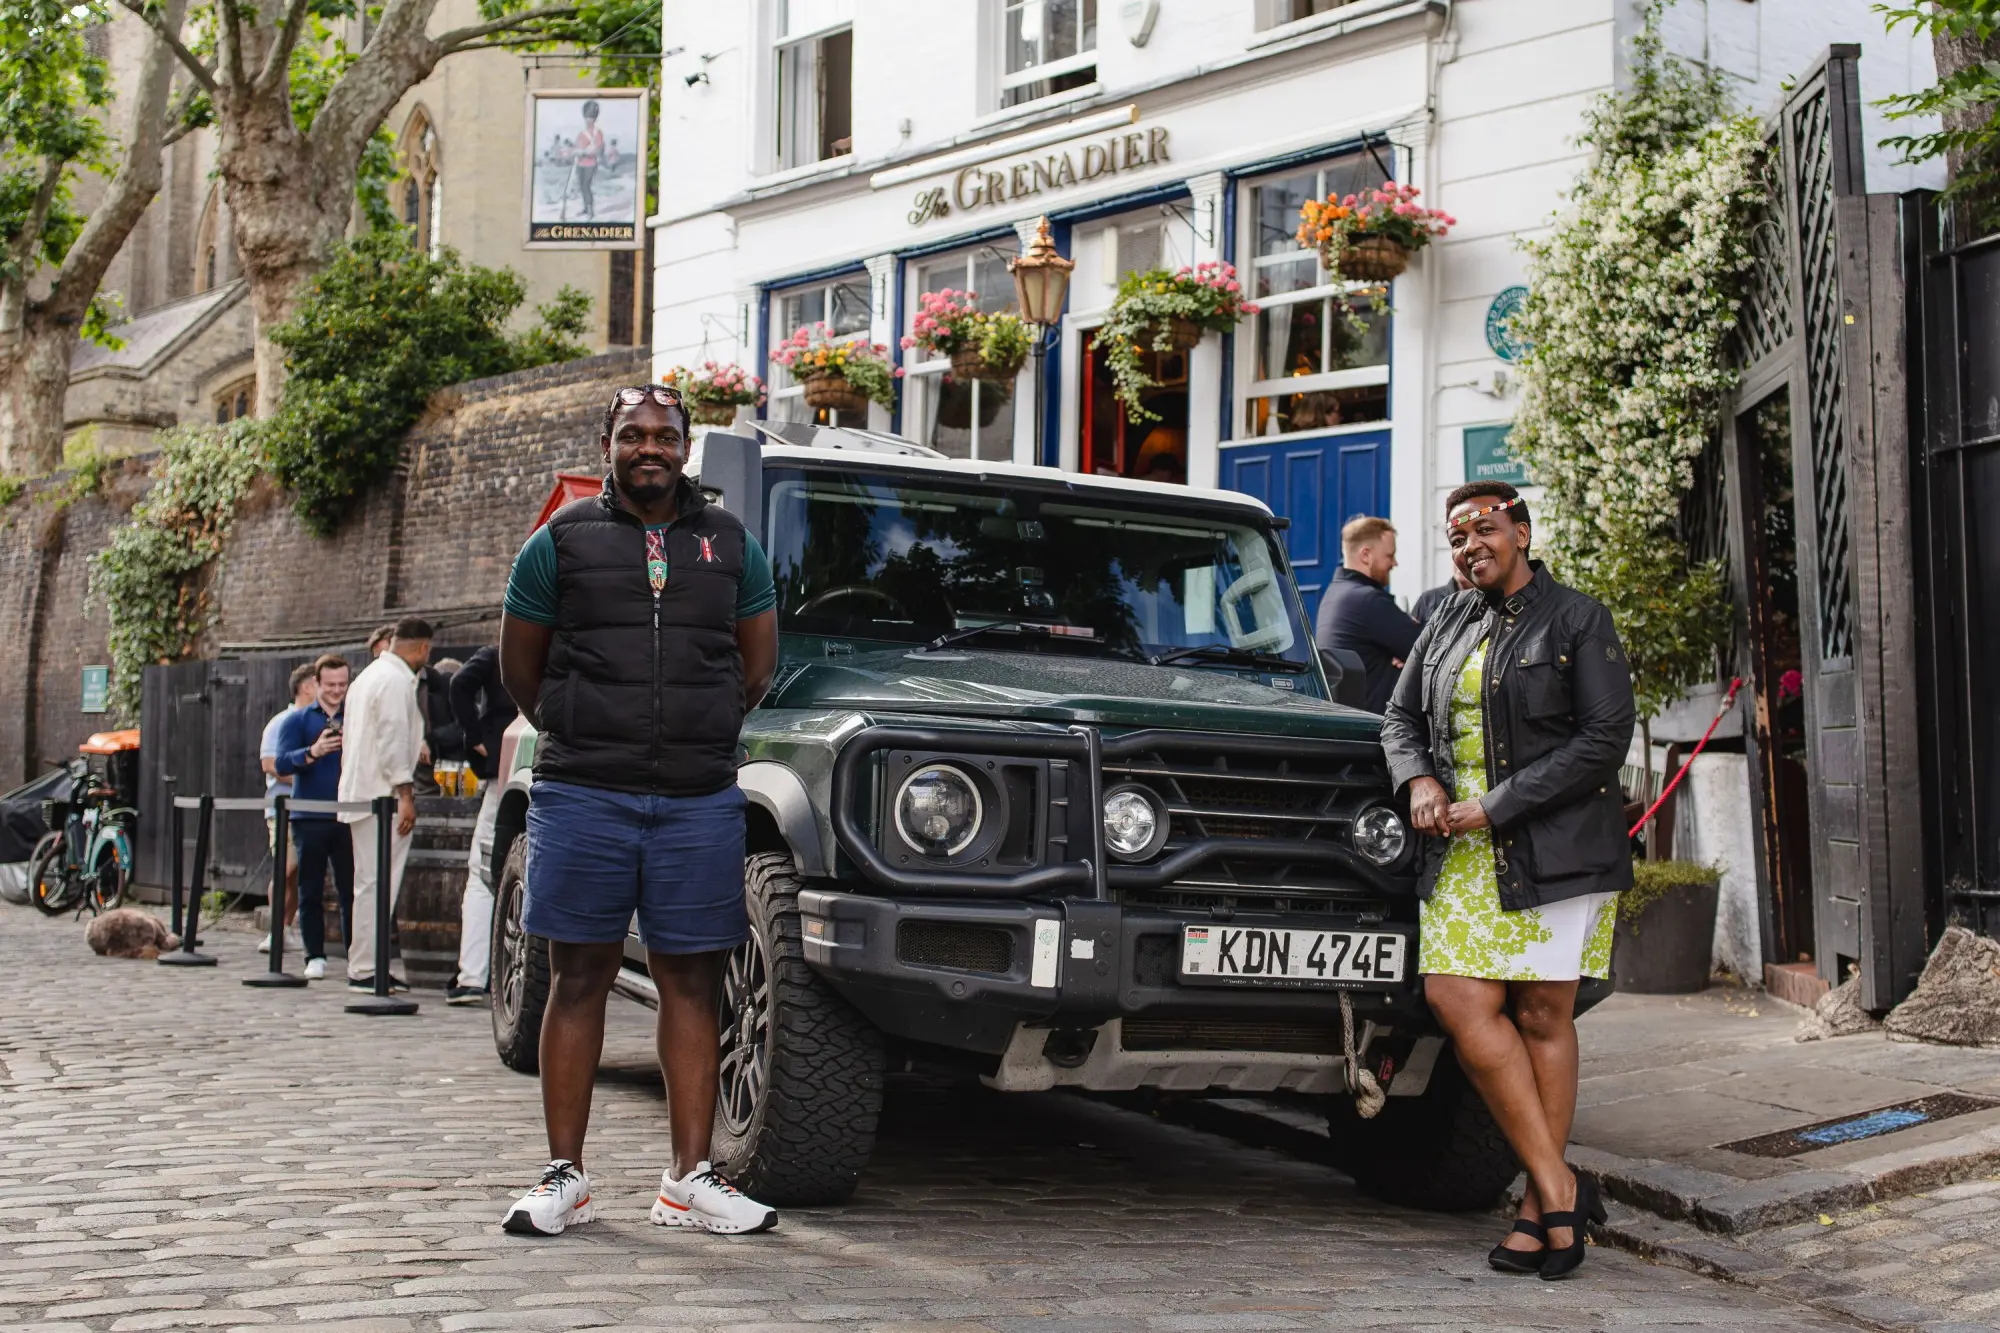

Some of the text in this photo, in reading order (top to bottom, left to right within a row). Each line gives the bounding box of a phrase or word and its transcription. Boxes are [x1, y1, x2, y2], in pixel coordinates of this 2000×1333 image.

[908, 126, 1171, 225] The GRENADIER
[550, 225, 633, 239] GRENADIER
[1476, 462, 1518, 476] PRIVATE
[1217, 929, 1291, 975] KDN
[1306, 933, 1397, 979] 474E
